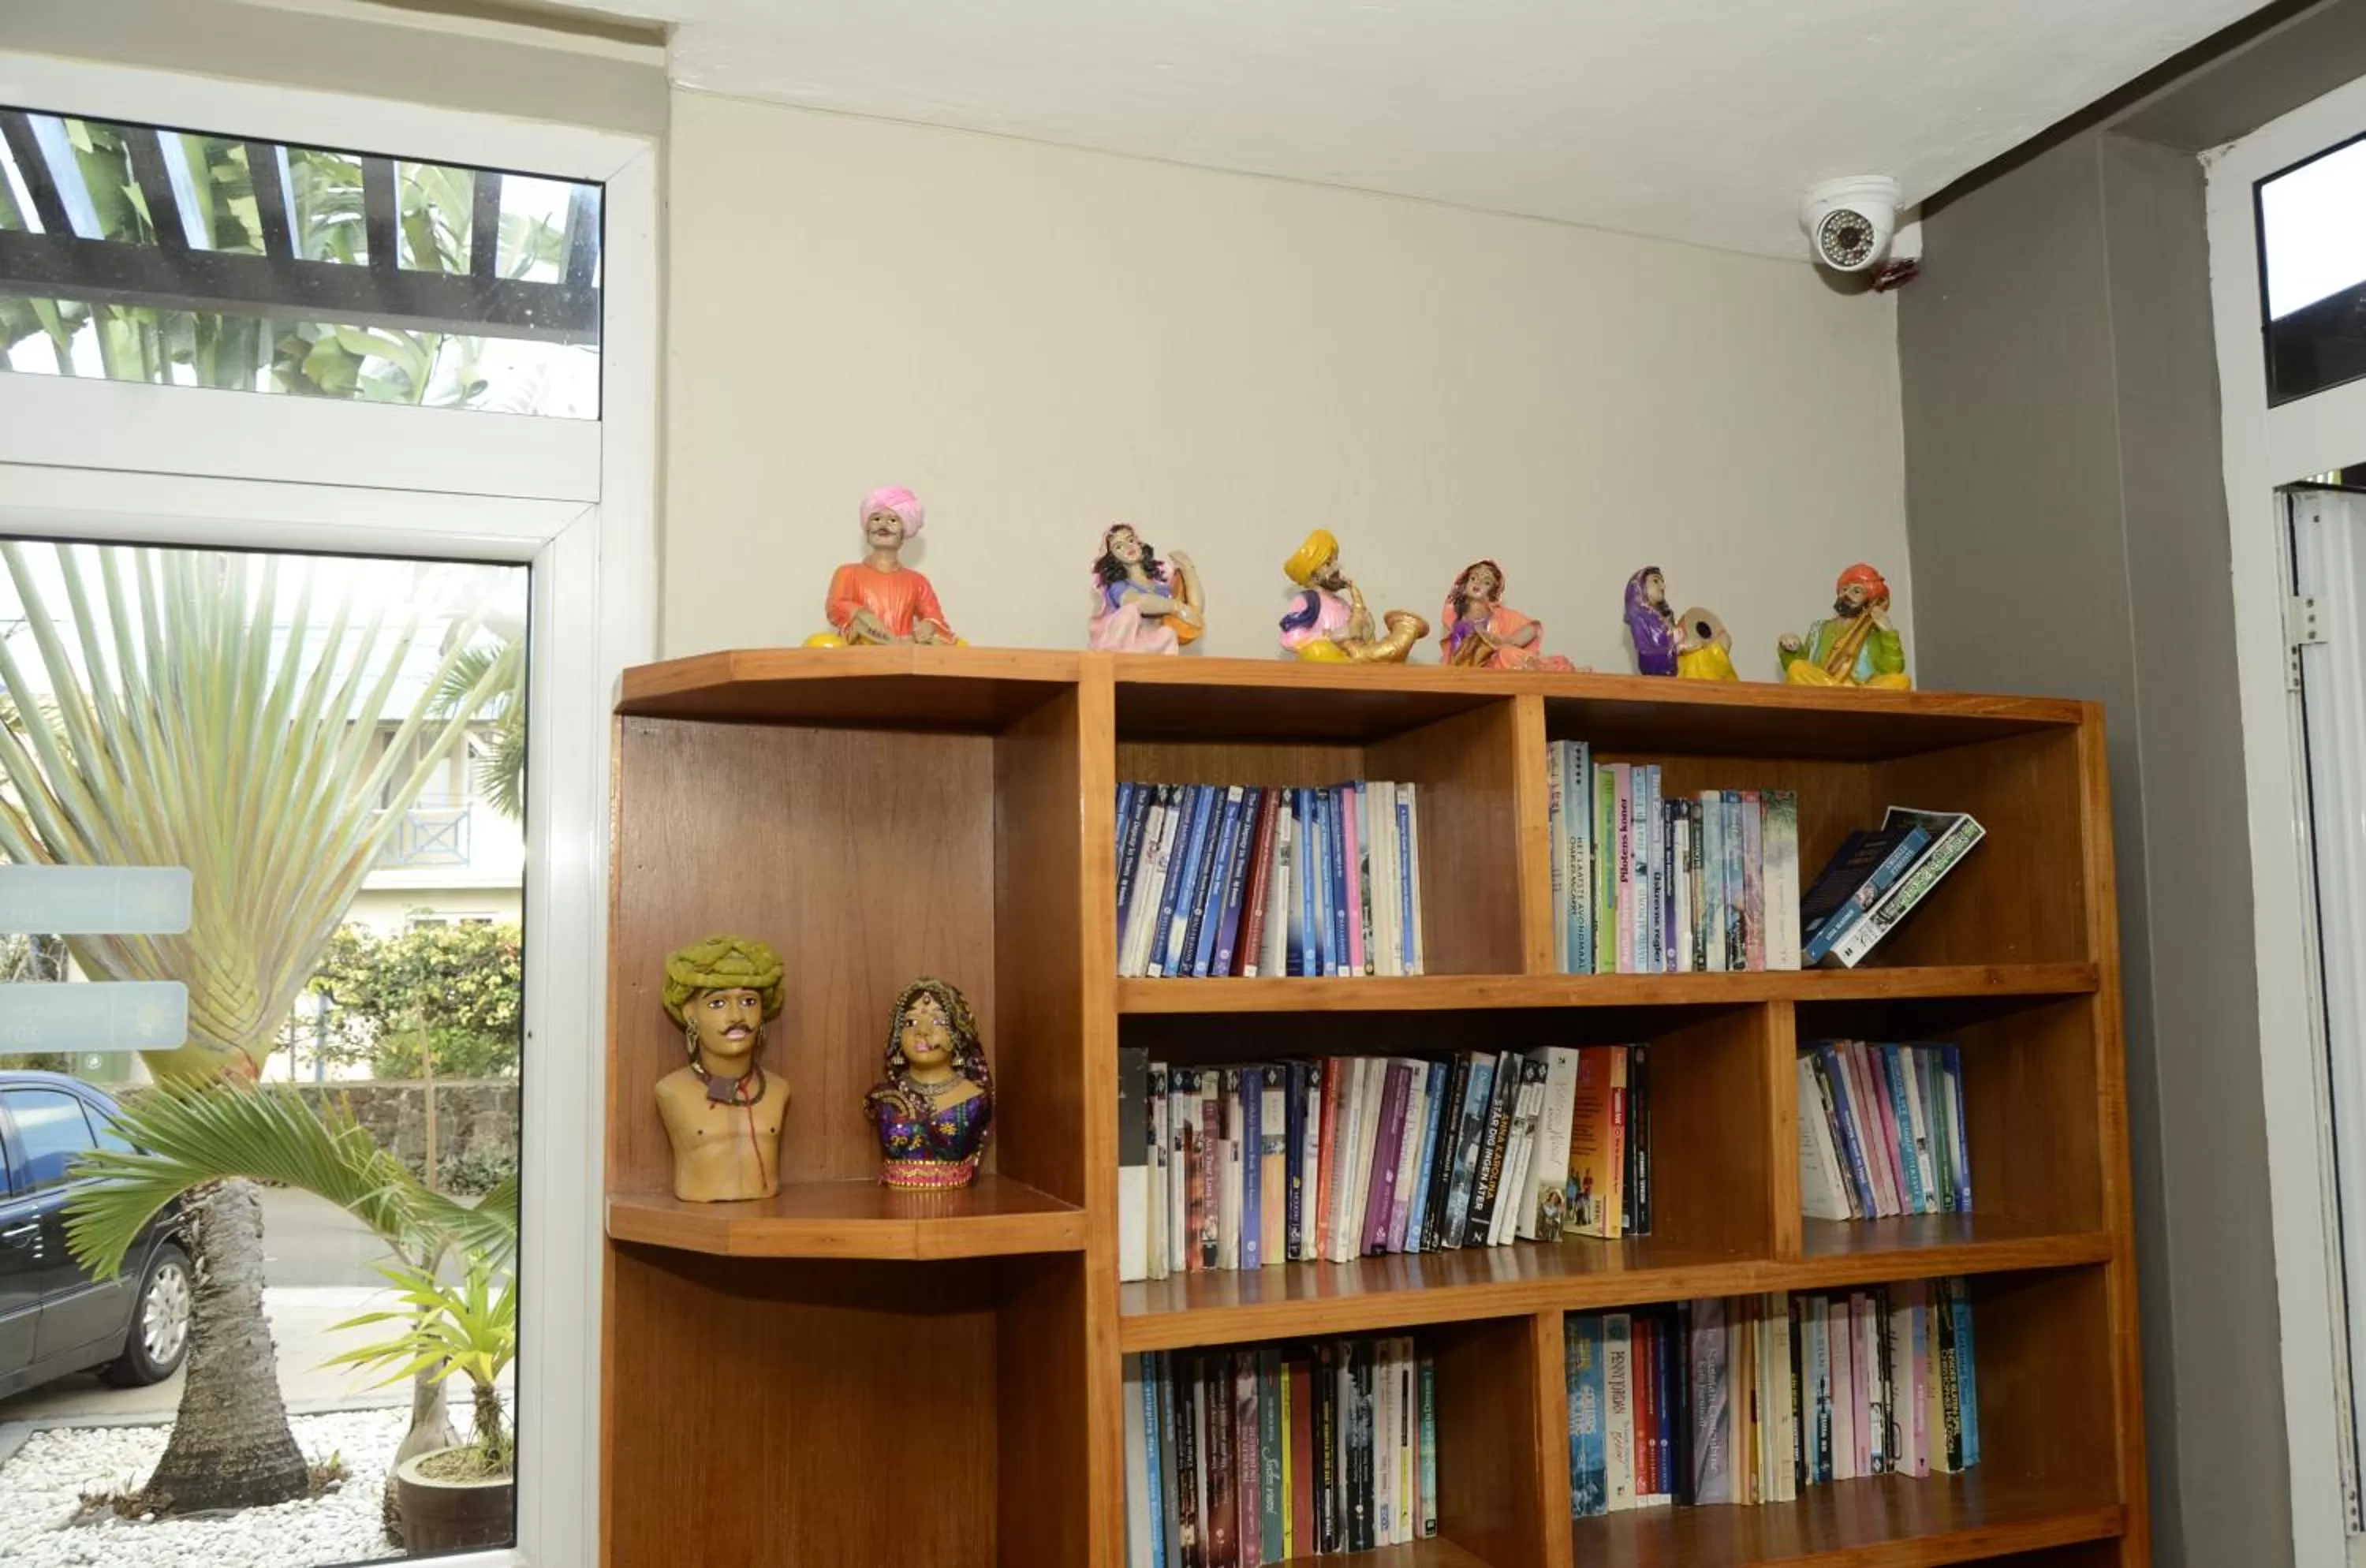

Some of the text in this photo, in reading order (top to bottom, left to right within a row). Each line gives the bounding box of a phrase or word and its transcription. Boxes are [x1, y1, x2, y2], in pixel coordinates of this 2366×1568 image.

[1577, 902, 1585, 969] AVONDMAAL
[1653, 928, 1662, 963] regler
[1474, 1099, 1505, 1211] STÅR DIG INGEN ÅTER
[1486, 1113, 1510, 1200] ANNA KAROLINA
[1609, 1351, 1627, 1414] PENNY JORDAN
